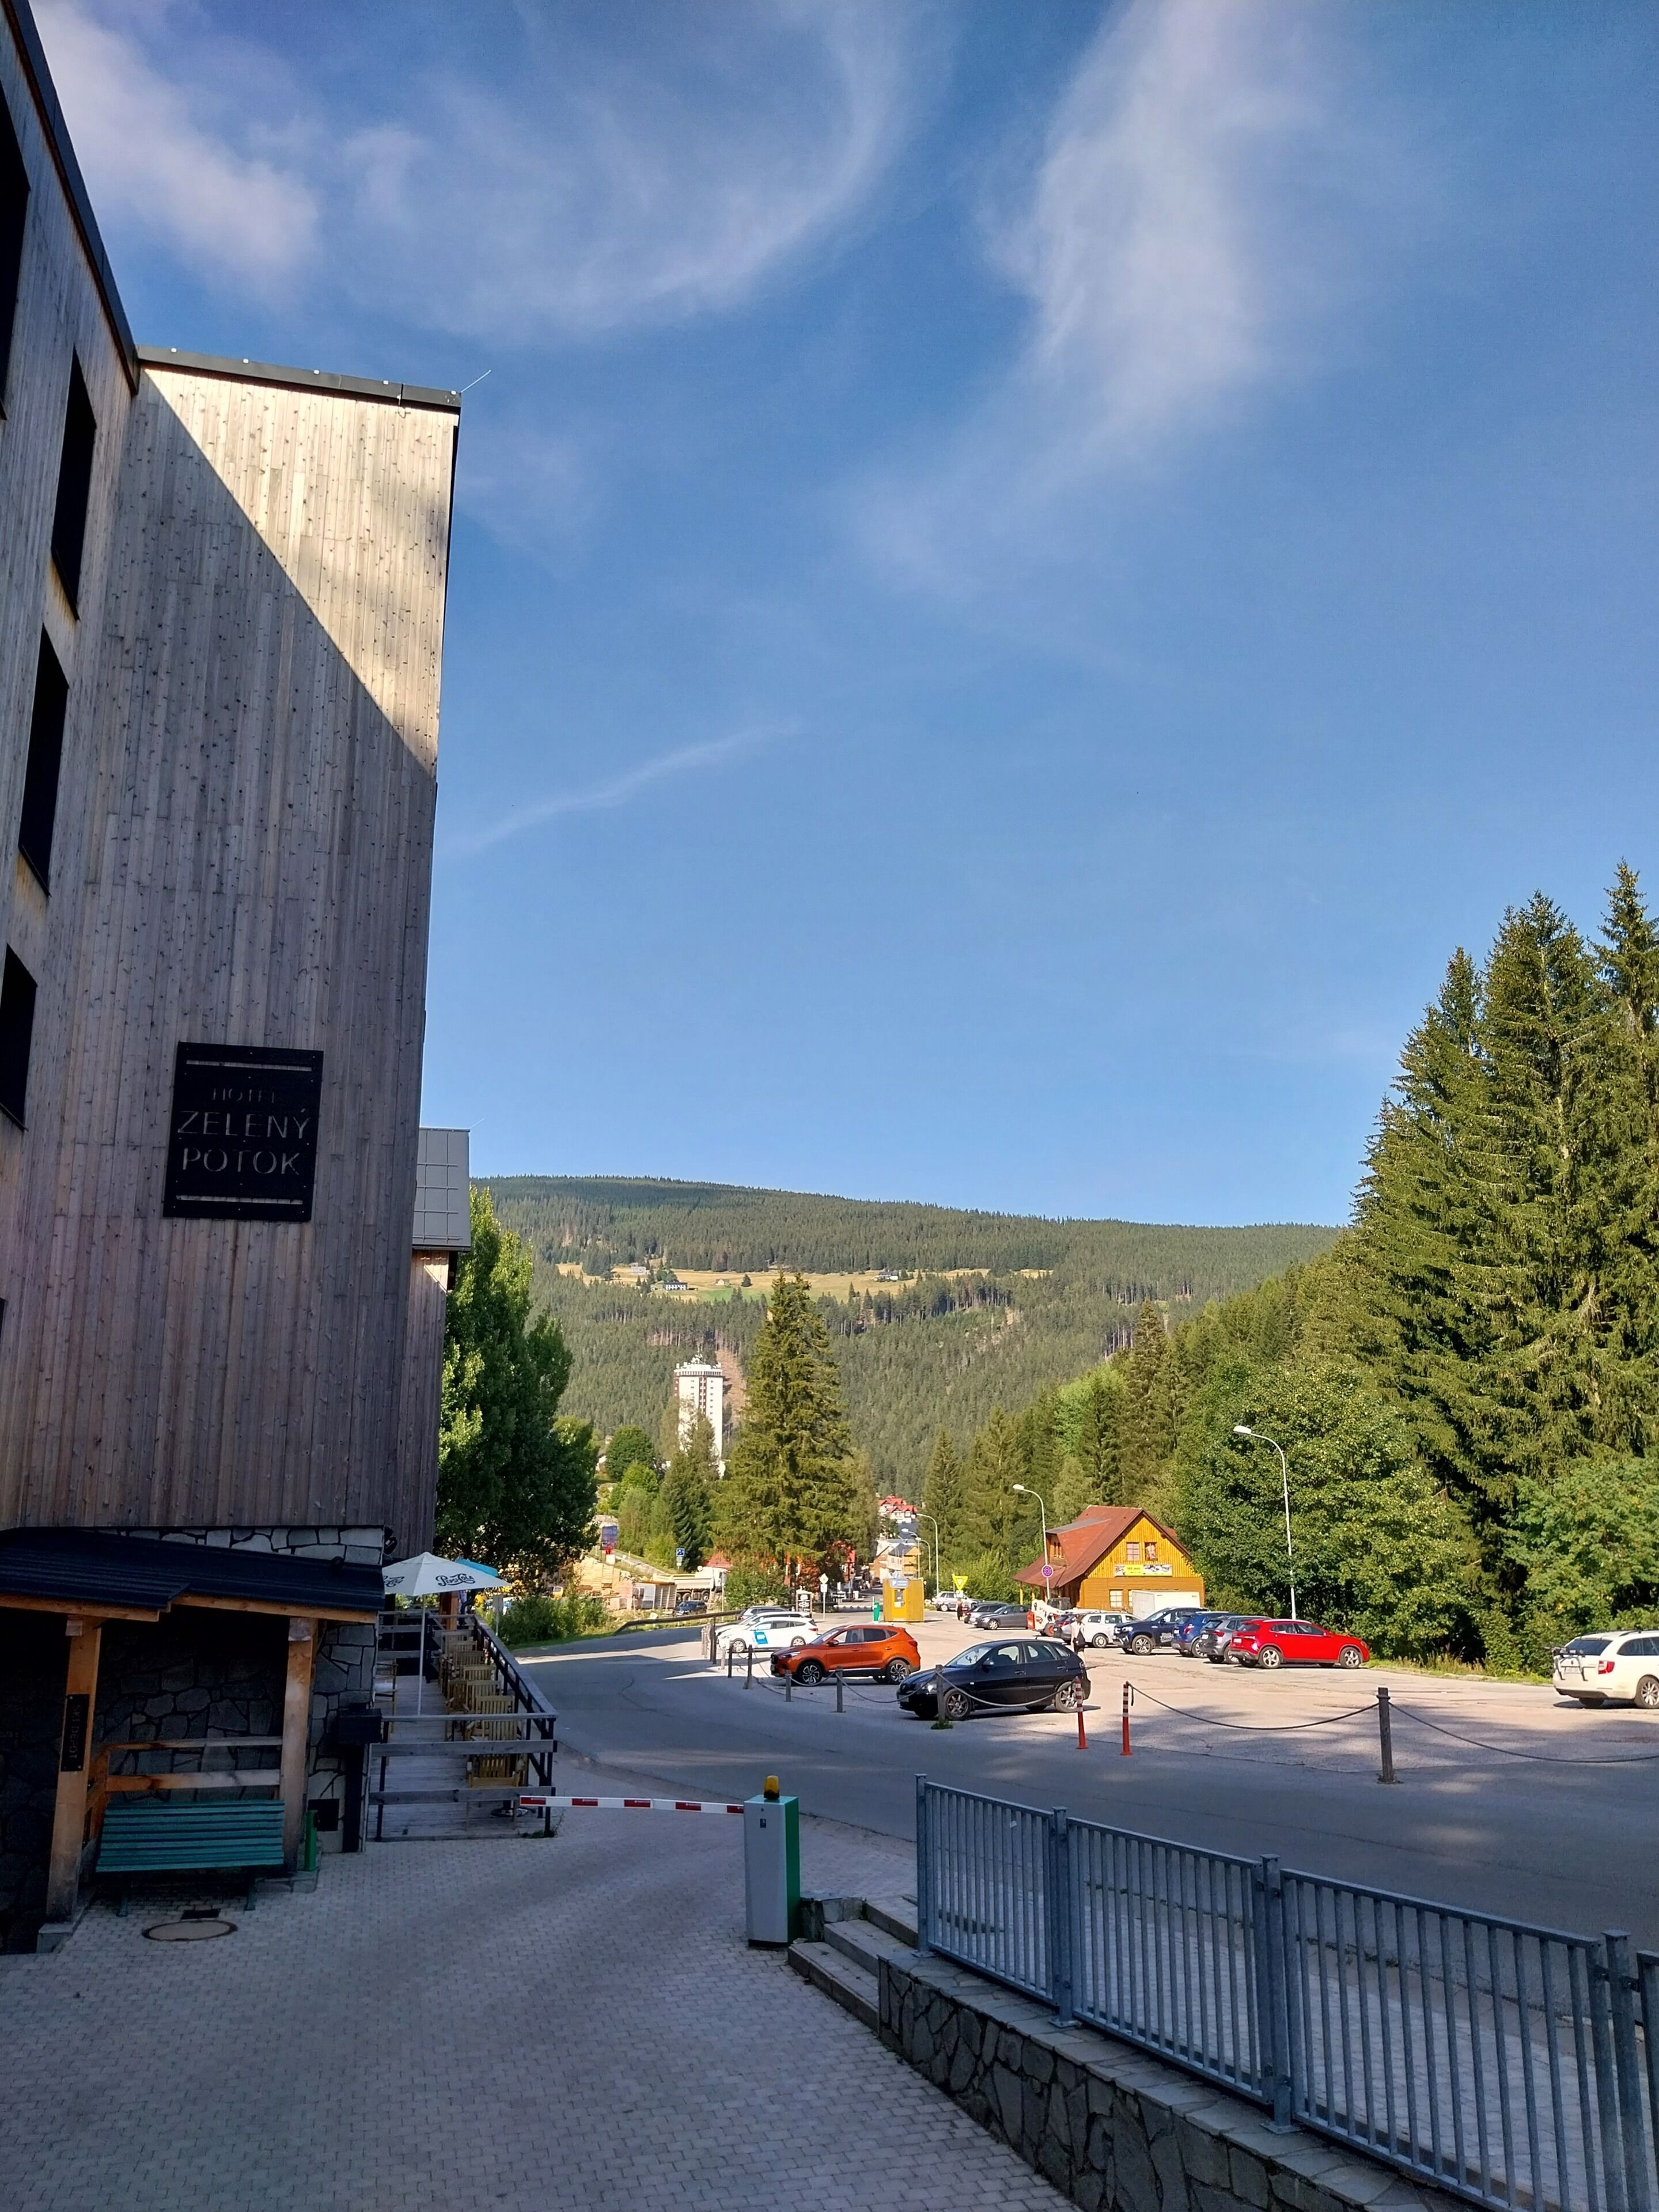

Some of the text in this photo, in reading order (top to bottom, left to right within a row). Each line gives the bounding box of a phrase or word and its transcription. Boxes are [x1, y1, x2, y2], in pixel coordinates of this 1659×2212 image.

[177, 1108, 311, 1138] ZELENÝ
[182, 1147, 300, 1176] POTOK
[69, 1705, 81, 1759] SKI DEPOT
